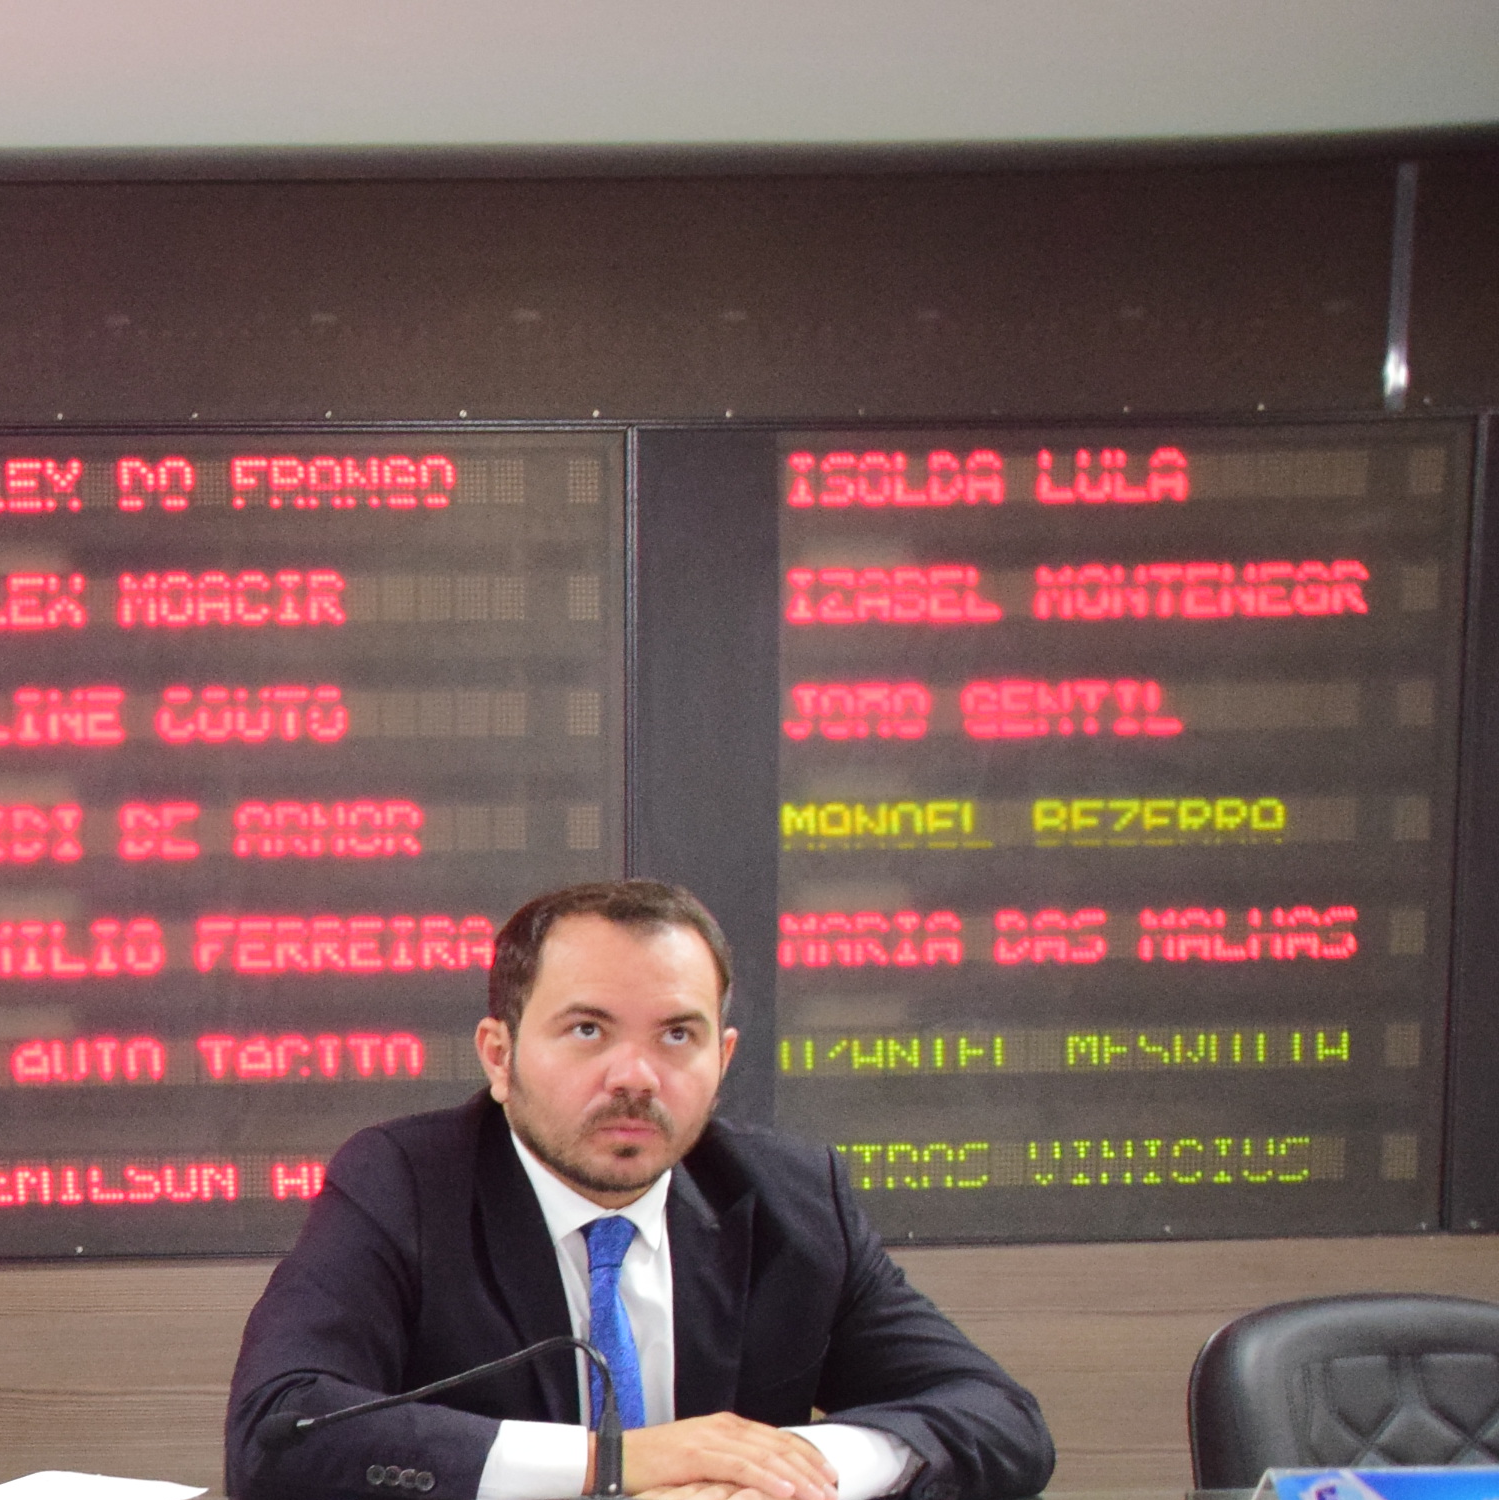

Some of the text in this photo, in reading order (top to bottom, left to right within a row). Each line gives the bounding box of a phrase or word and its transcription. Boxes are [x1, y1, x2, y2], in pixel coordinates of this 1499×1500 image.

[787, 446, 1190, 507] ISOLDA LULA
[117, 570, 346, 625] MOACIR
[786, 565, 1001, 624] IZABEL
[154, 685, 348, 743] COUTO
[119, 801, 200, 858] DE
[194, 915, 497, 974] FERREIRA
[778, 911, 962, 967] MARIA
[993, 908, 1107, 964] DAS
